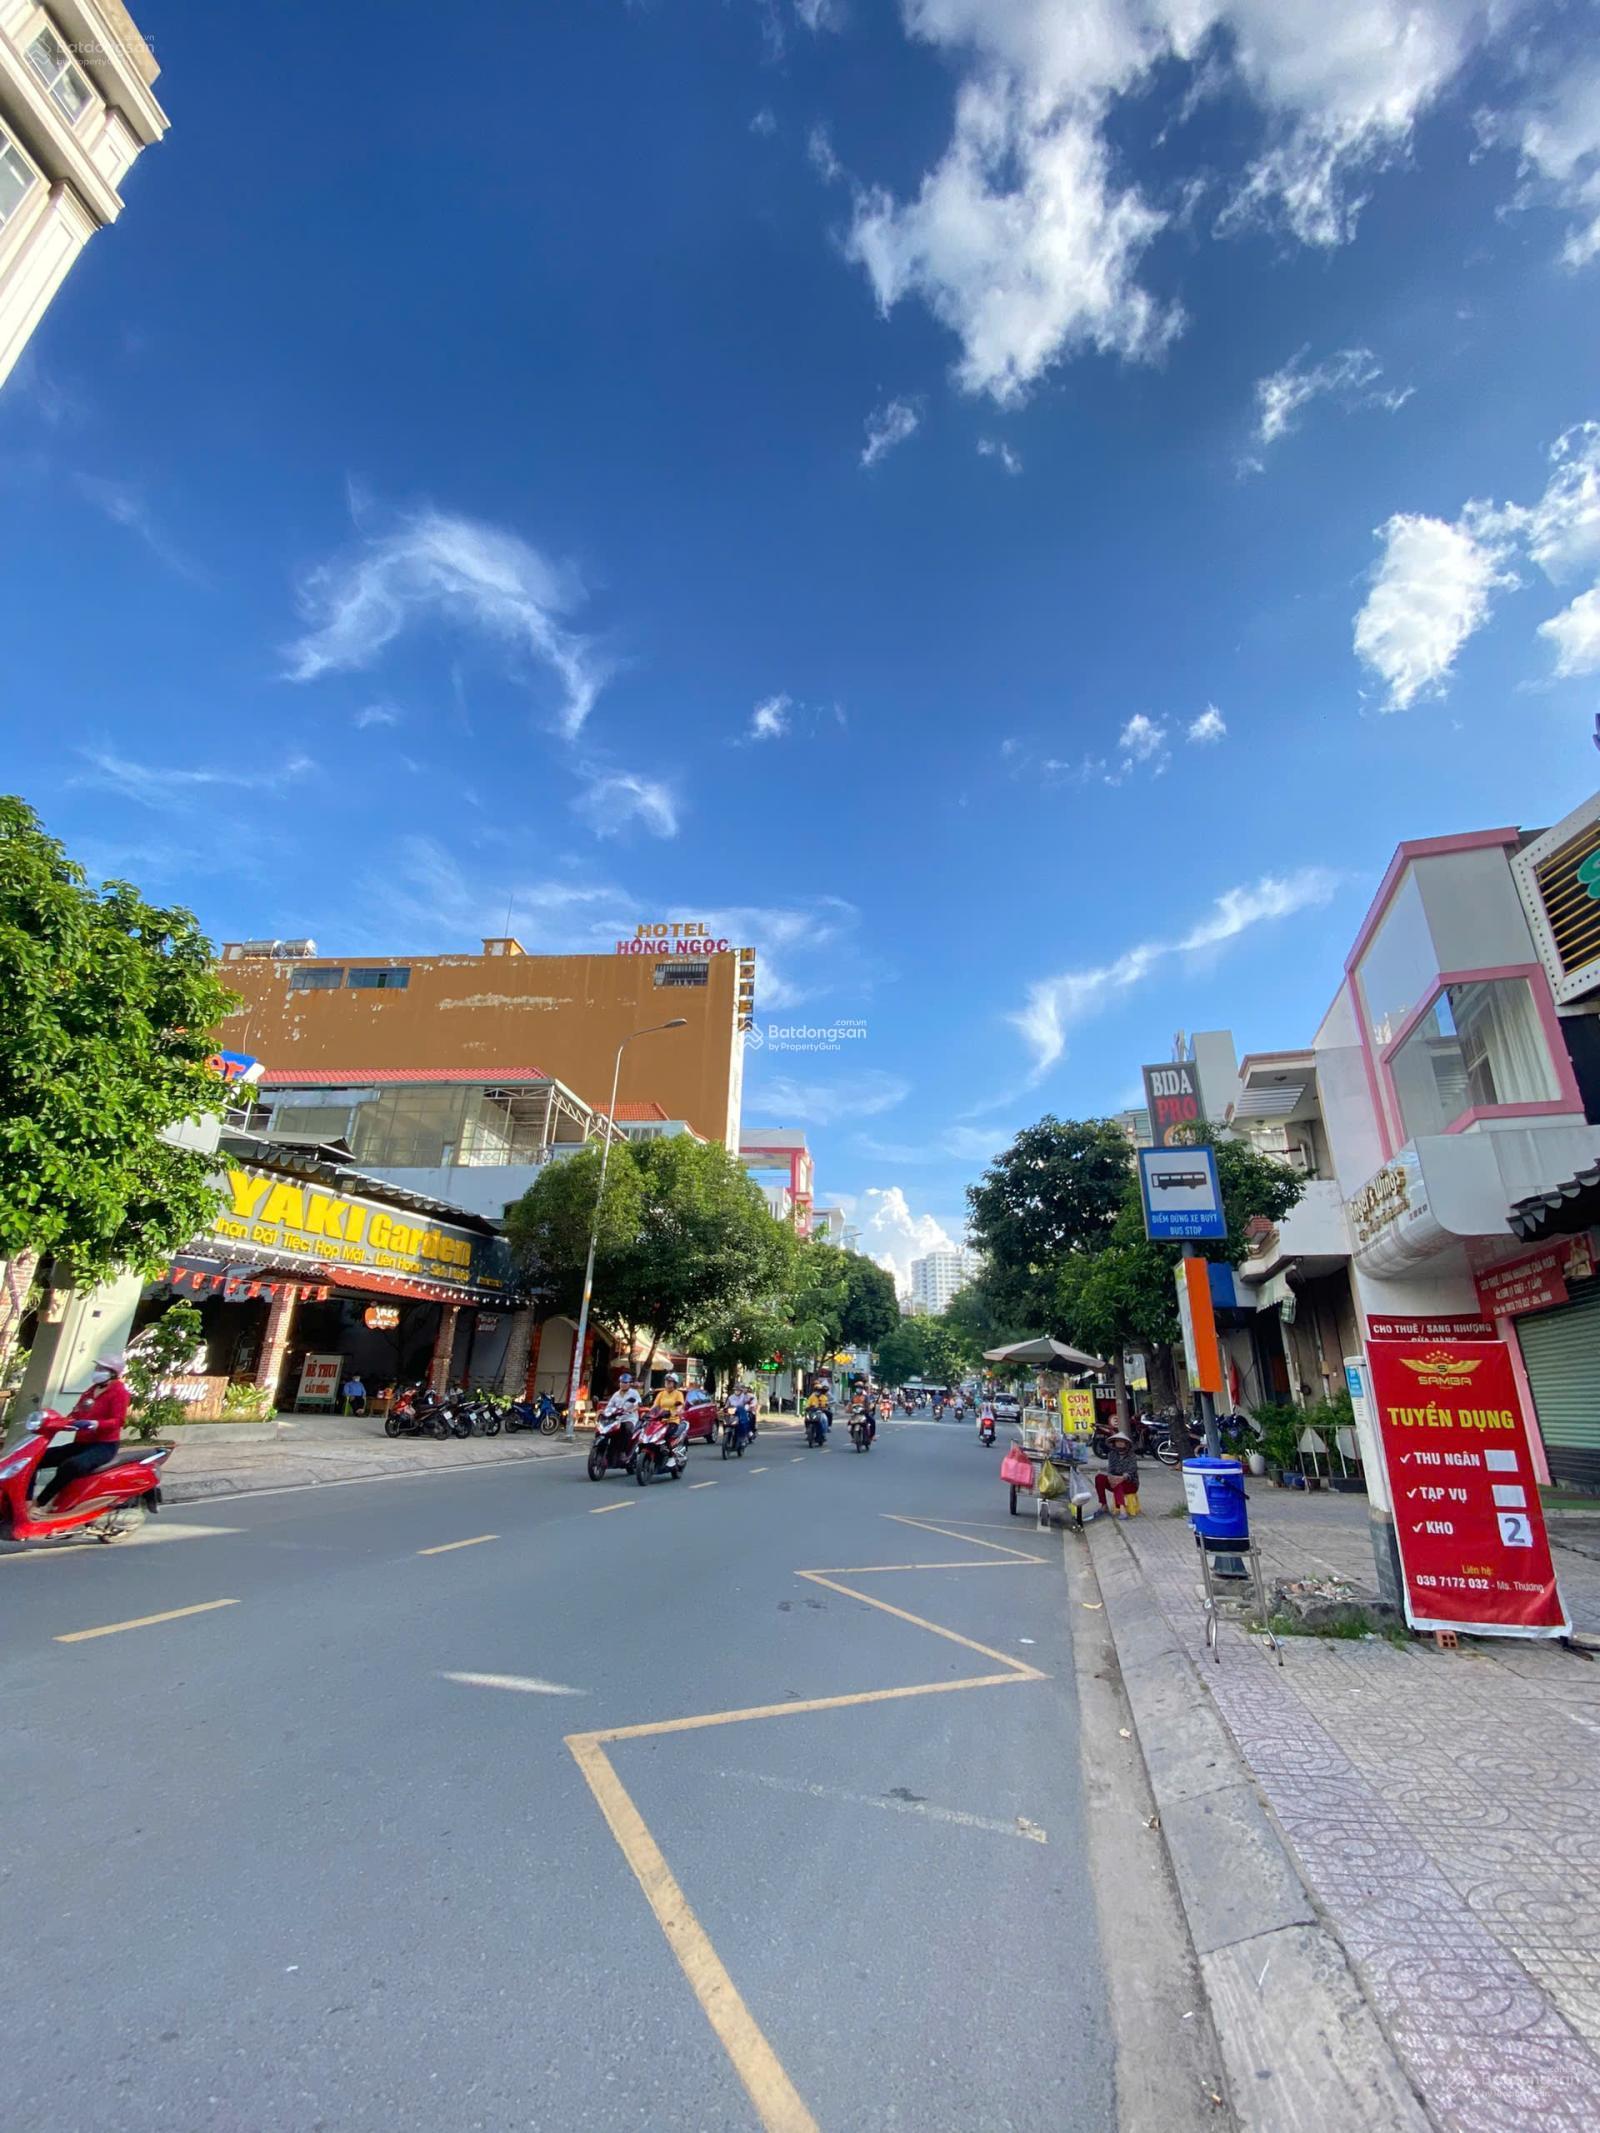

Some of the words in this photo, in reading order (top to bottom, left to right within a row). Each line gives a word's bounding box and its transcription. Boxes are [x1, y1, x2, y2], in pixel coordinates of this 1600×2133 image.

[637, 922, 710, 938] HOTEL
[617, 936, 669, 955] HỒNG
[676, 939, 730, 956] NGỌC
[1150, 1069, 1193, 1097] BIDA
[1155, 1096, 1198, 1125] PRO
[227, 1170, 367, 1243] YAKI
[1190, 1213, 1200, 1223] XE
[1170, 1226, 1184, 1235] BUS
[1184, 1225, 1202, 1235] STOP
[368, 1212, 473, 1267] Garden
[314, 1239, 340, 1259] Họp
[1373, 1324, 1393, 1334] CHO
[1394, 1323, 1419, 1334] THUÊ
[1426, 1324, 1451, 1333] SANG
[1453, 1322, 1492, 1334] NHƯỢNG
[318, 1363, 338, 1378] THUI
[1417, 1376, 1472, 1386] SAMBA
[1067, 1393, 1089, 1404] CƠM
[1387, 1400, 1453, 1427] TUYỂN
[1458, 1409, 1515, 1432] DỤNG
[1414, 1451, 1440, 1465] THU
[1445, 1451, 1480, 1467] NGÂN
[1419, 1486, 1445, 1502] TẠP
[1449, 1488, 1467, 1504] VỤ
[1426, 1521, 1454, 1535] KHO
[1504, 1517, 1525, 1544] 2
[1462, 1564, 1479, 1575] Liên
[1416, 1575, 1437, 1586] 039
[1439, 1576, 1466, 1588] 7172
[1468, 1577, 1490, 1590] 032
[1497, 1581, 1512, 1591] Ms.
[1514, 1582, 1545, 1594] Thương
